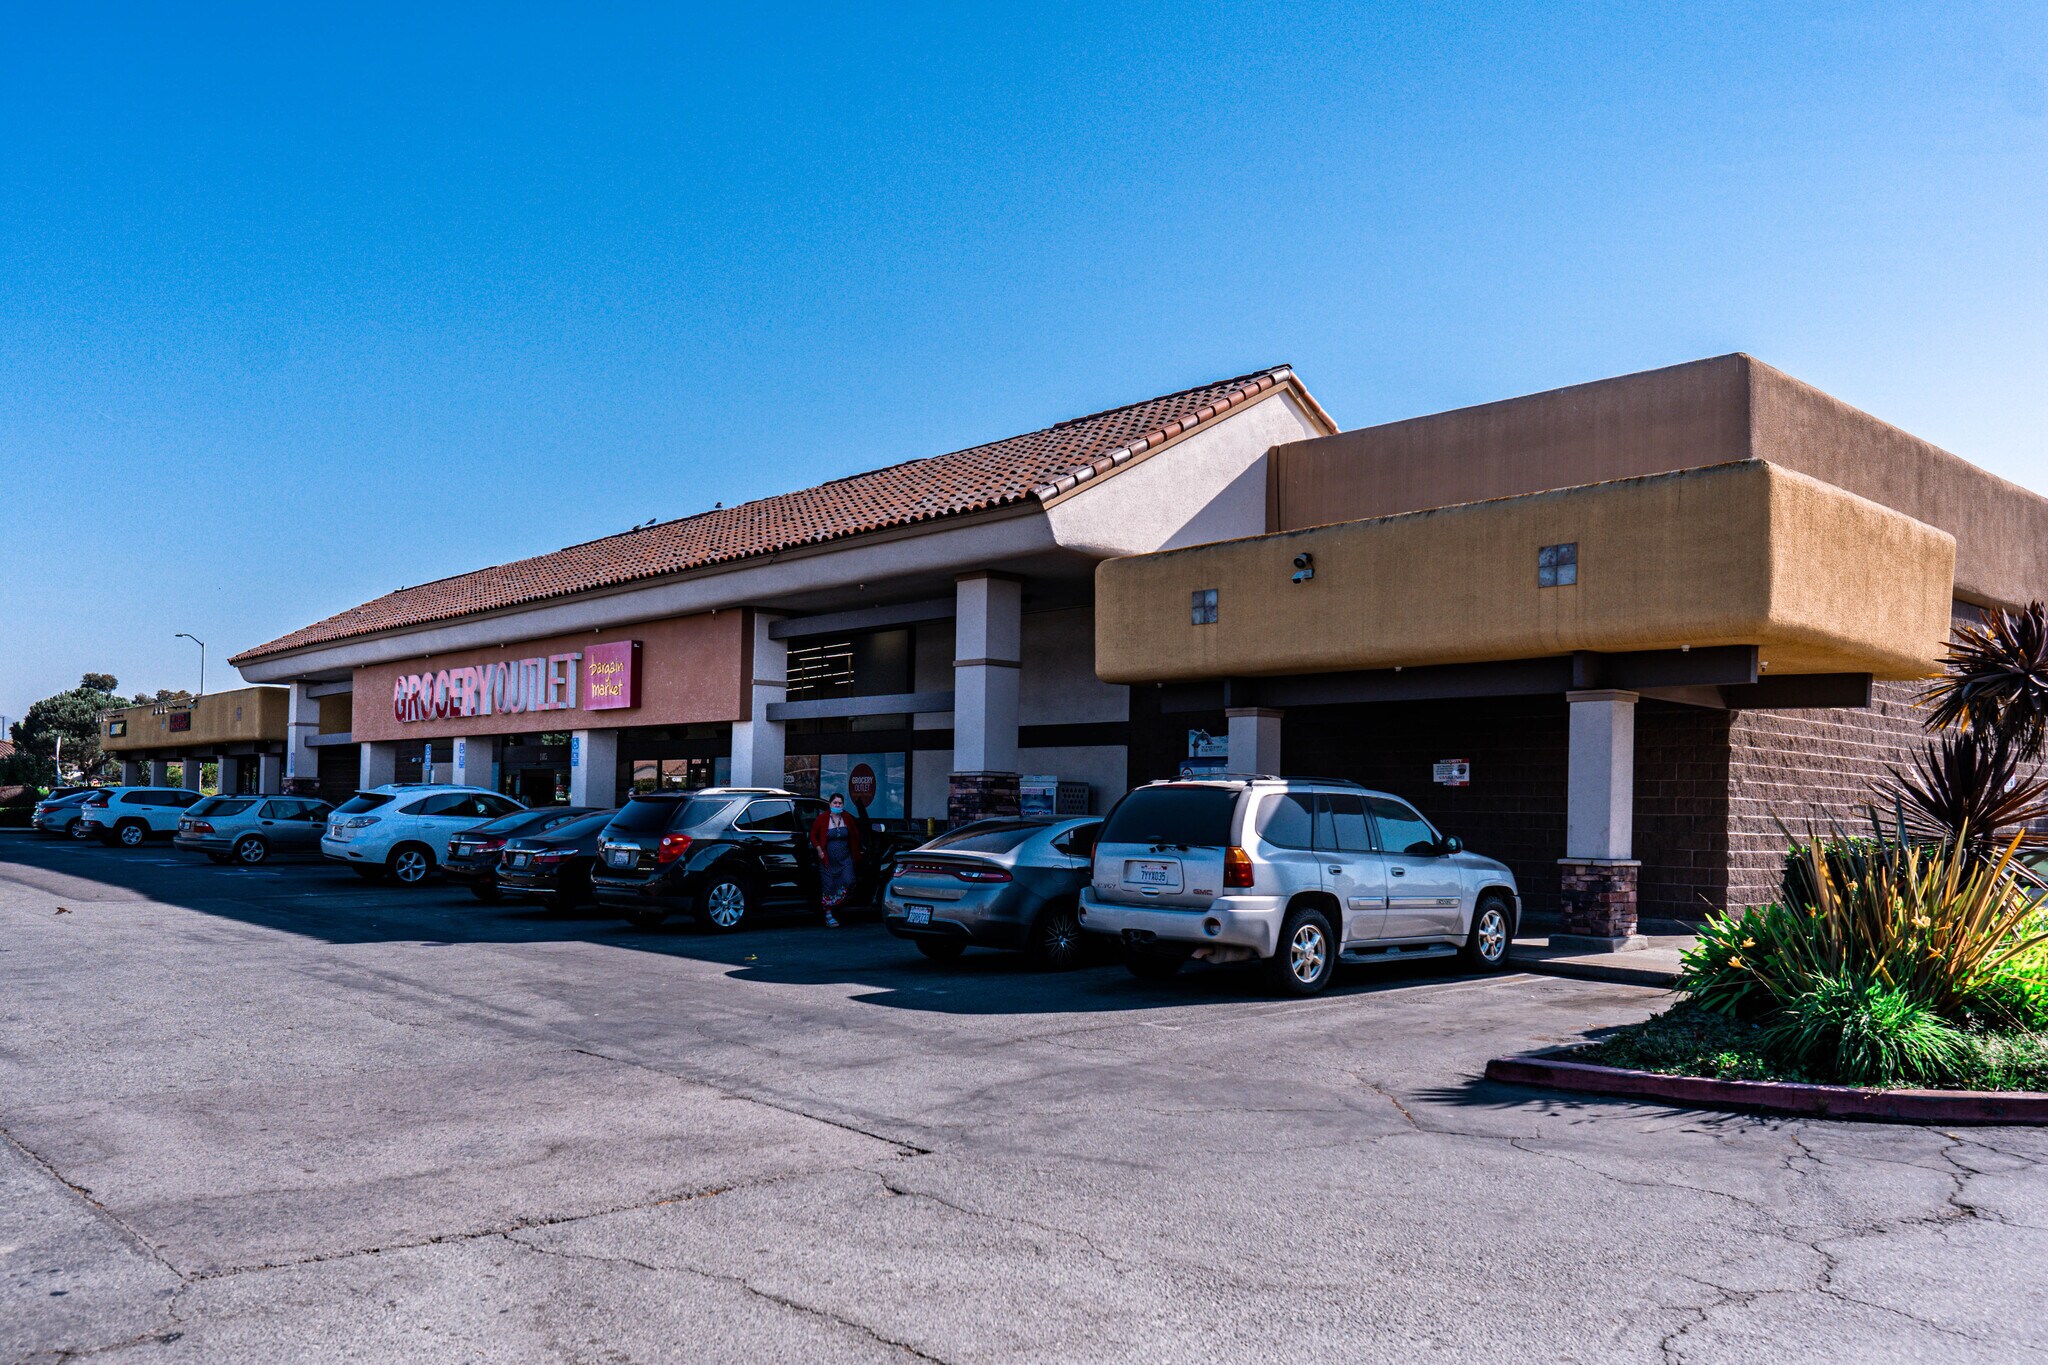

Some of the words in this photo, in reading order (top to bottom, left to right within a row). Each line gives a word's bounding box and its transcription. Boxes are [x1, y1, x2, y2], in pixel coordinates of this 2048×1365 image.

[588, 653, 625, 682] bargain
[394, 664, 496, 722] GROCERY
[494, 652, 583, 714] OUTLET
[591, 678, 624, 699] market
[851, 776, 874, 785] GROCERY
[854, 783, 871, 792] OUTLET
